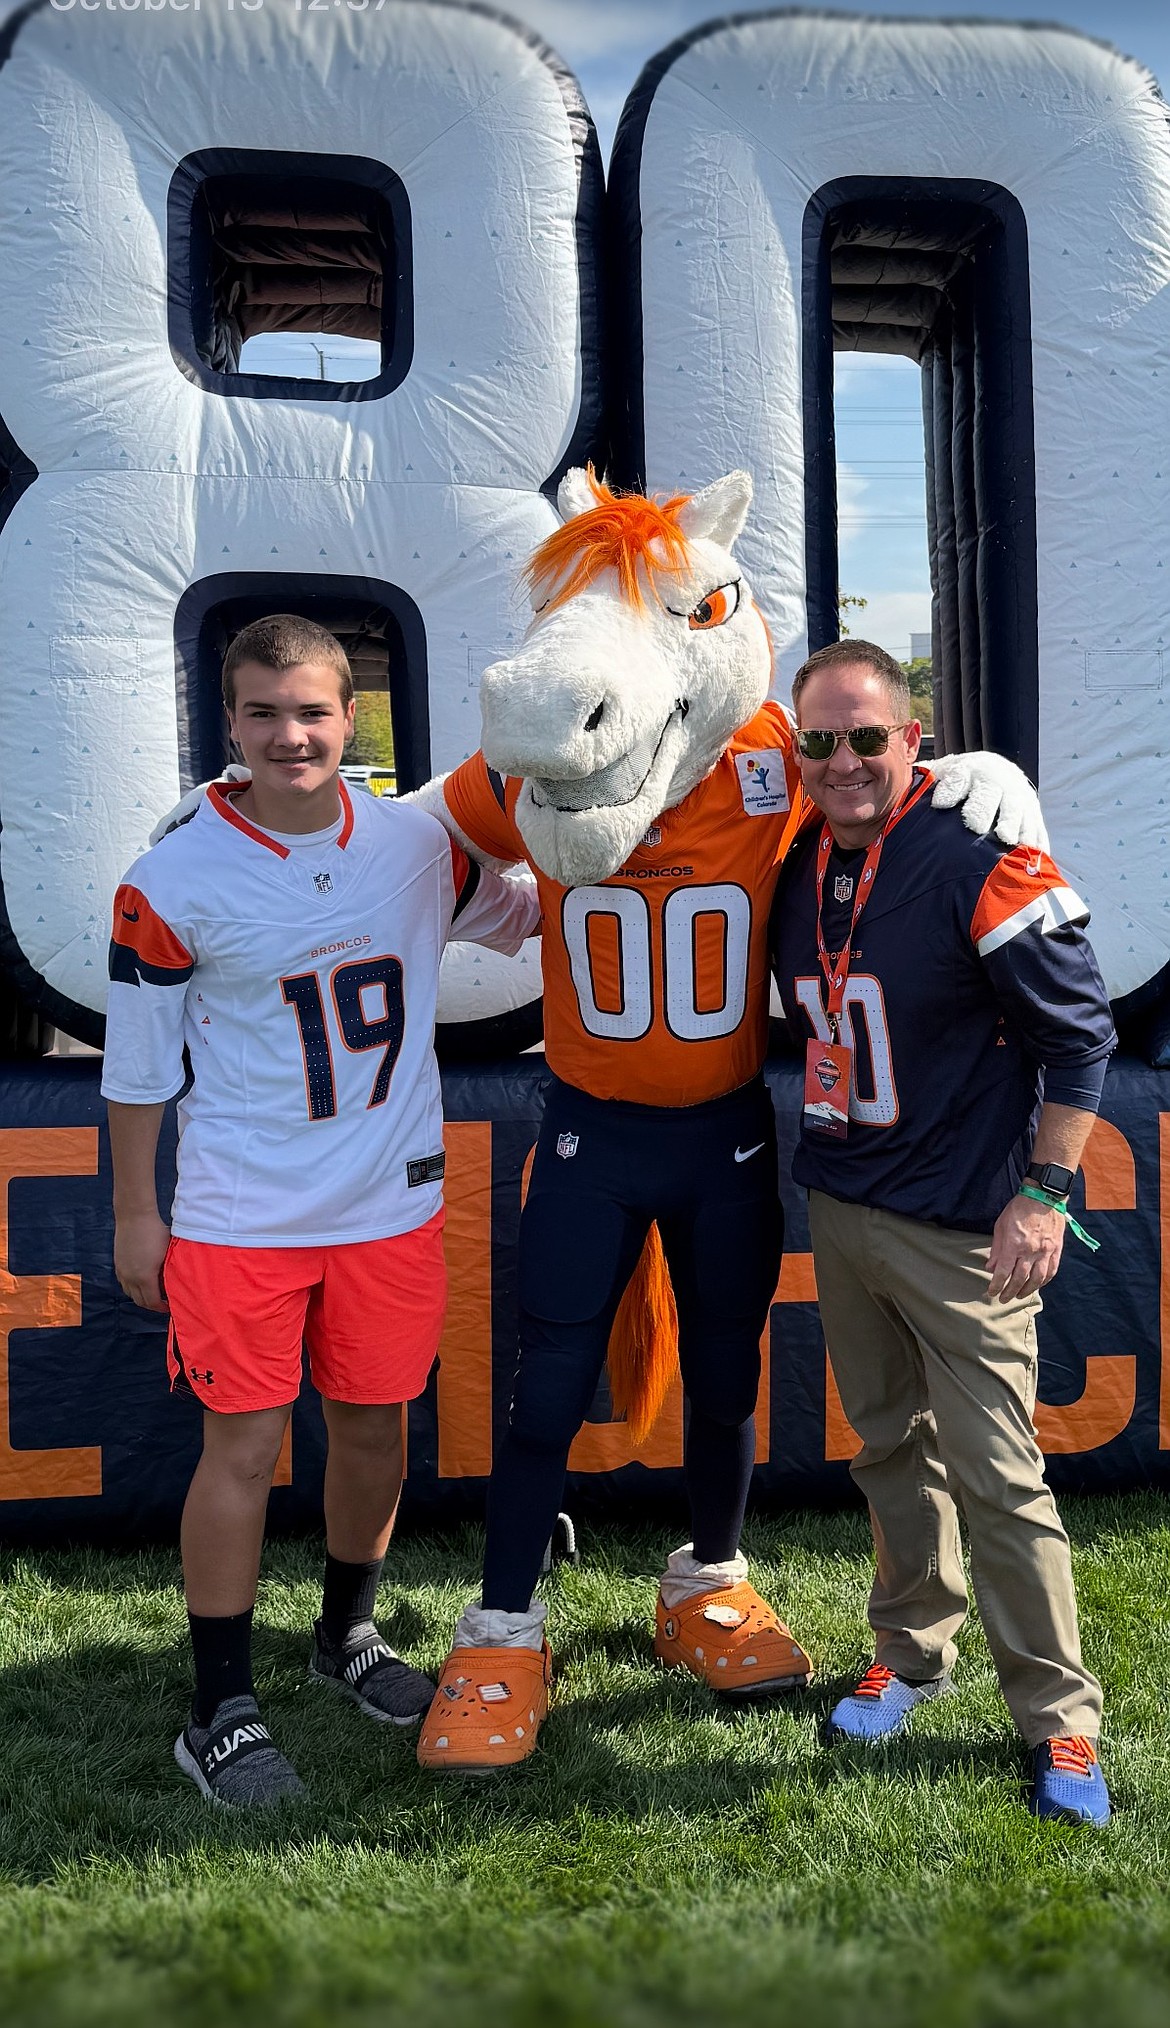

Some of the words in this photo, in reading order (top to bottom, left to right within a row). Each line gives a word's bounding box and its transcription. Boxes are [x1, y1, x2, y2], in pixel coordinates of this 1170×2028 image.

[310, 935, 372, 959] BRONCOS
[560, 881, 753, 1042] 00
[278, 954, 406, 1121] 19
